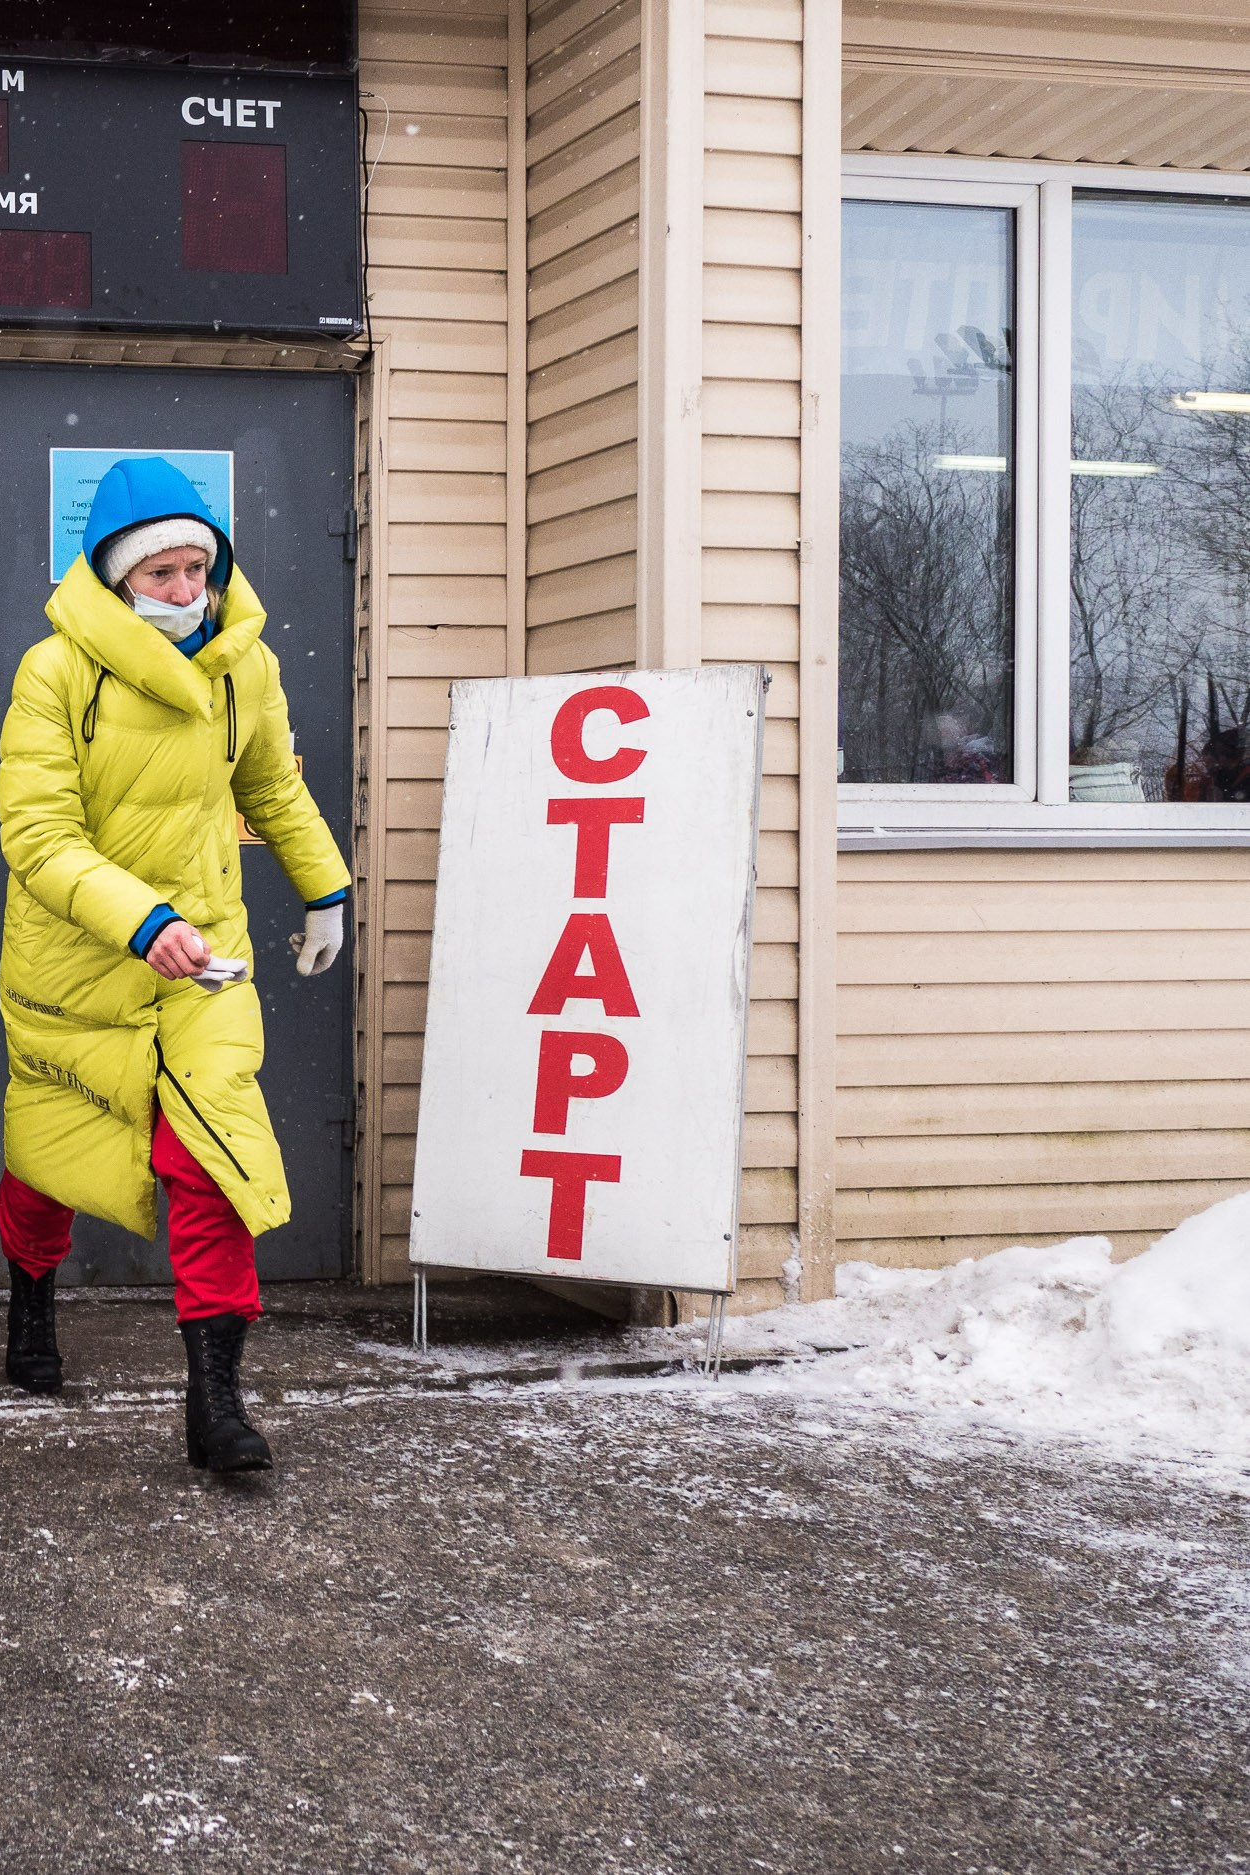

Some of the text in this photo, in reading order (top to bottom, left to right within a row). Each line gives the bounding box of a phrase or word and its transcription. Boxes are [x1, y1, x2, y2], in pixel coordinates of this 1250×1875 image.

[181, 96, 282, 129] СЧЕТ
[520, 685, 651, 1261] СТАРТ
[5, 985, 65, 1016] SOMETHING
